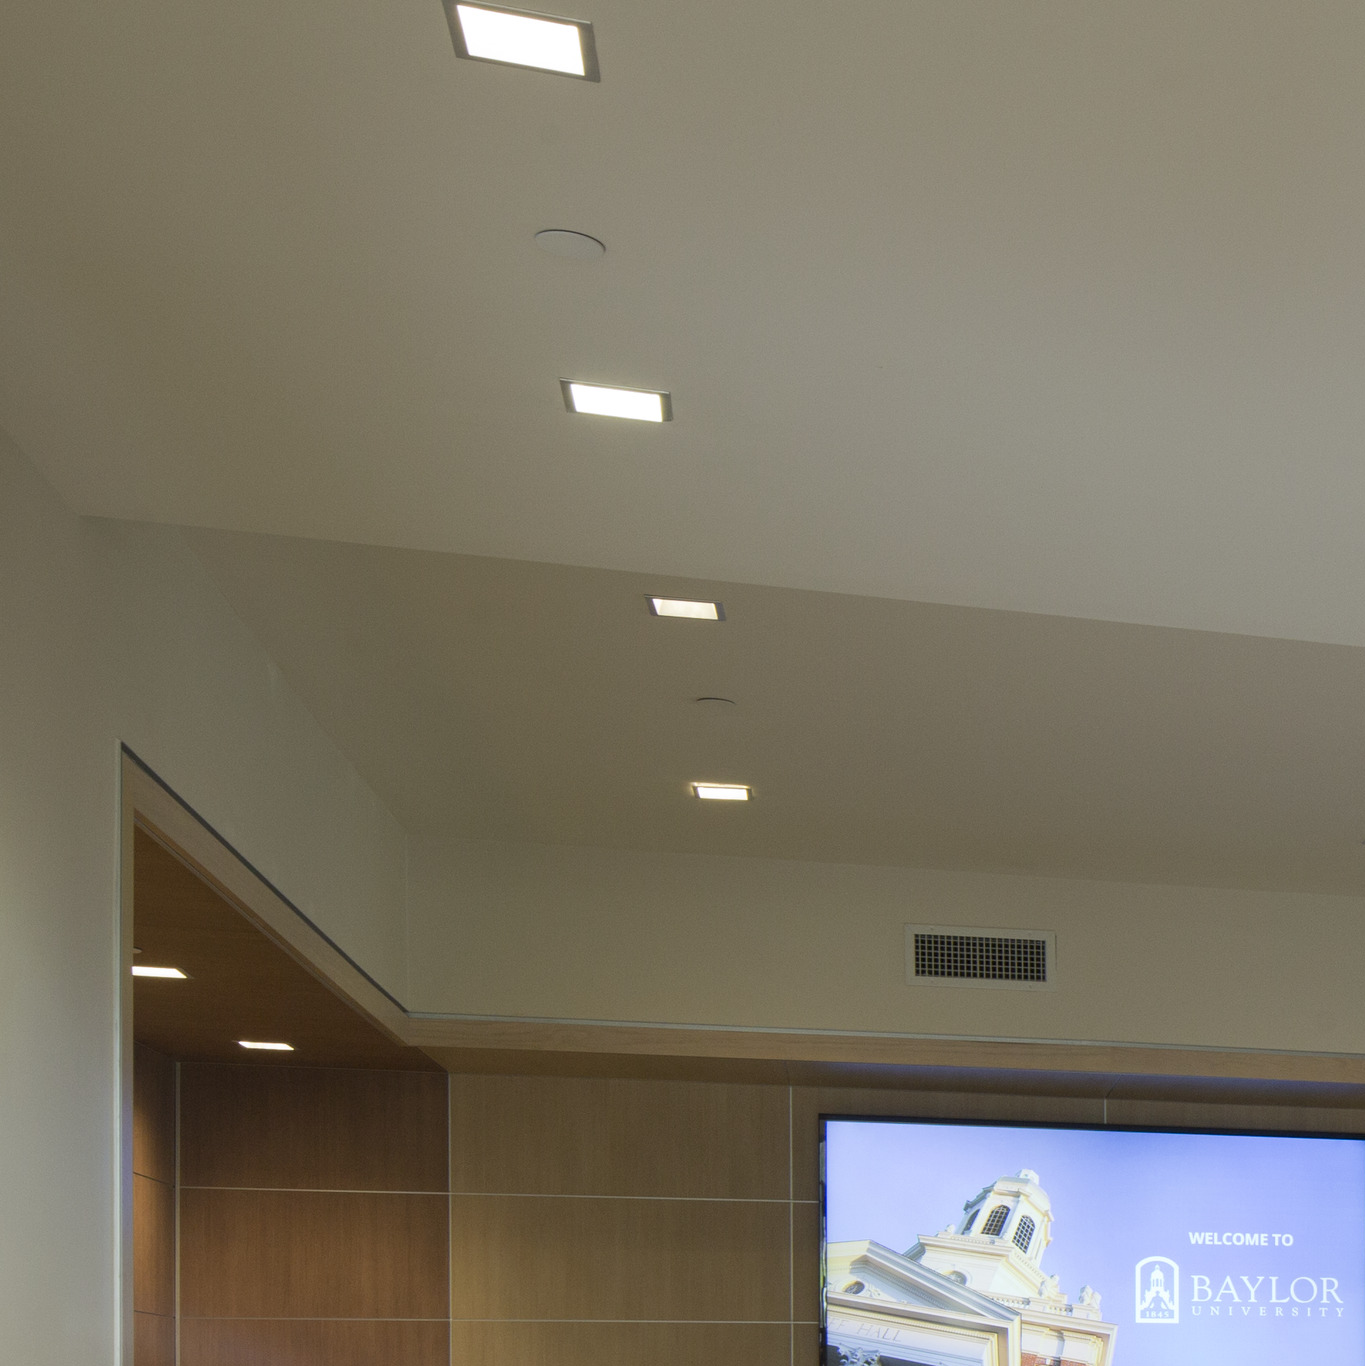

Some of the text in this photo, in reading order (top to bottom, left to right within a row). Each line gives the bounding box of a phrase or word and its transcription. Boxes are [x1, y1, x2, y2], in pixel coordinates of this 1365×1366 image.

[1188, 1232, 1294, 1247] WELCOME TO
[1190, 1275, 1344, 1304] BAYLOR
[1145, 1310, 1169, 1318] 1845
[1191, 1306, 1344, 1317] UNIVERSITY
[857, 1323, 902, 1342] HALL
